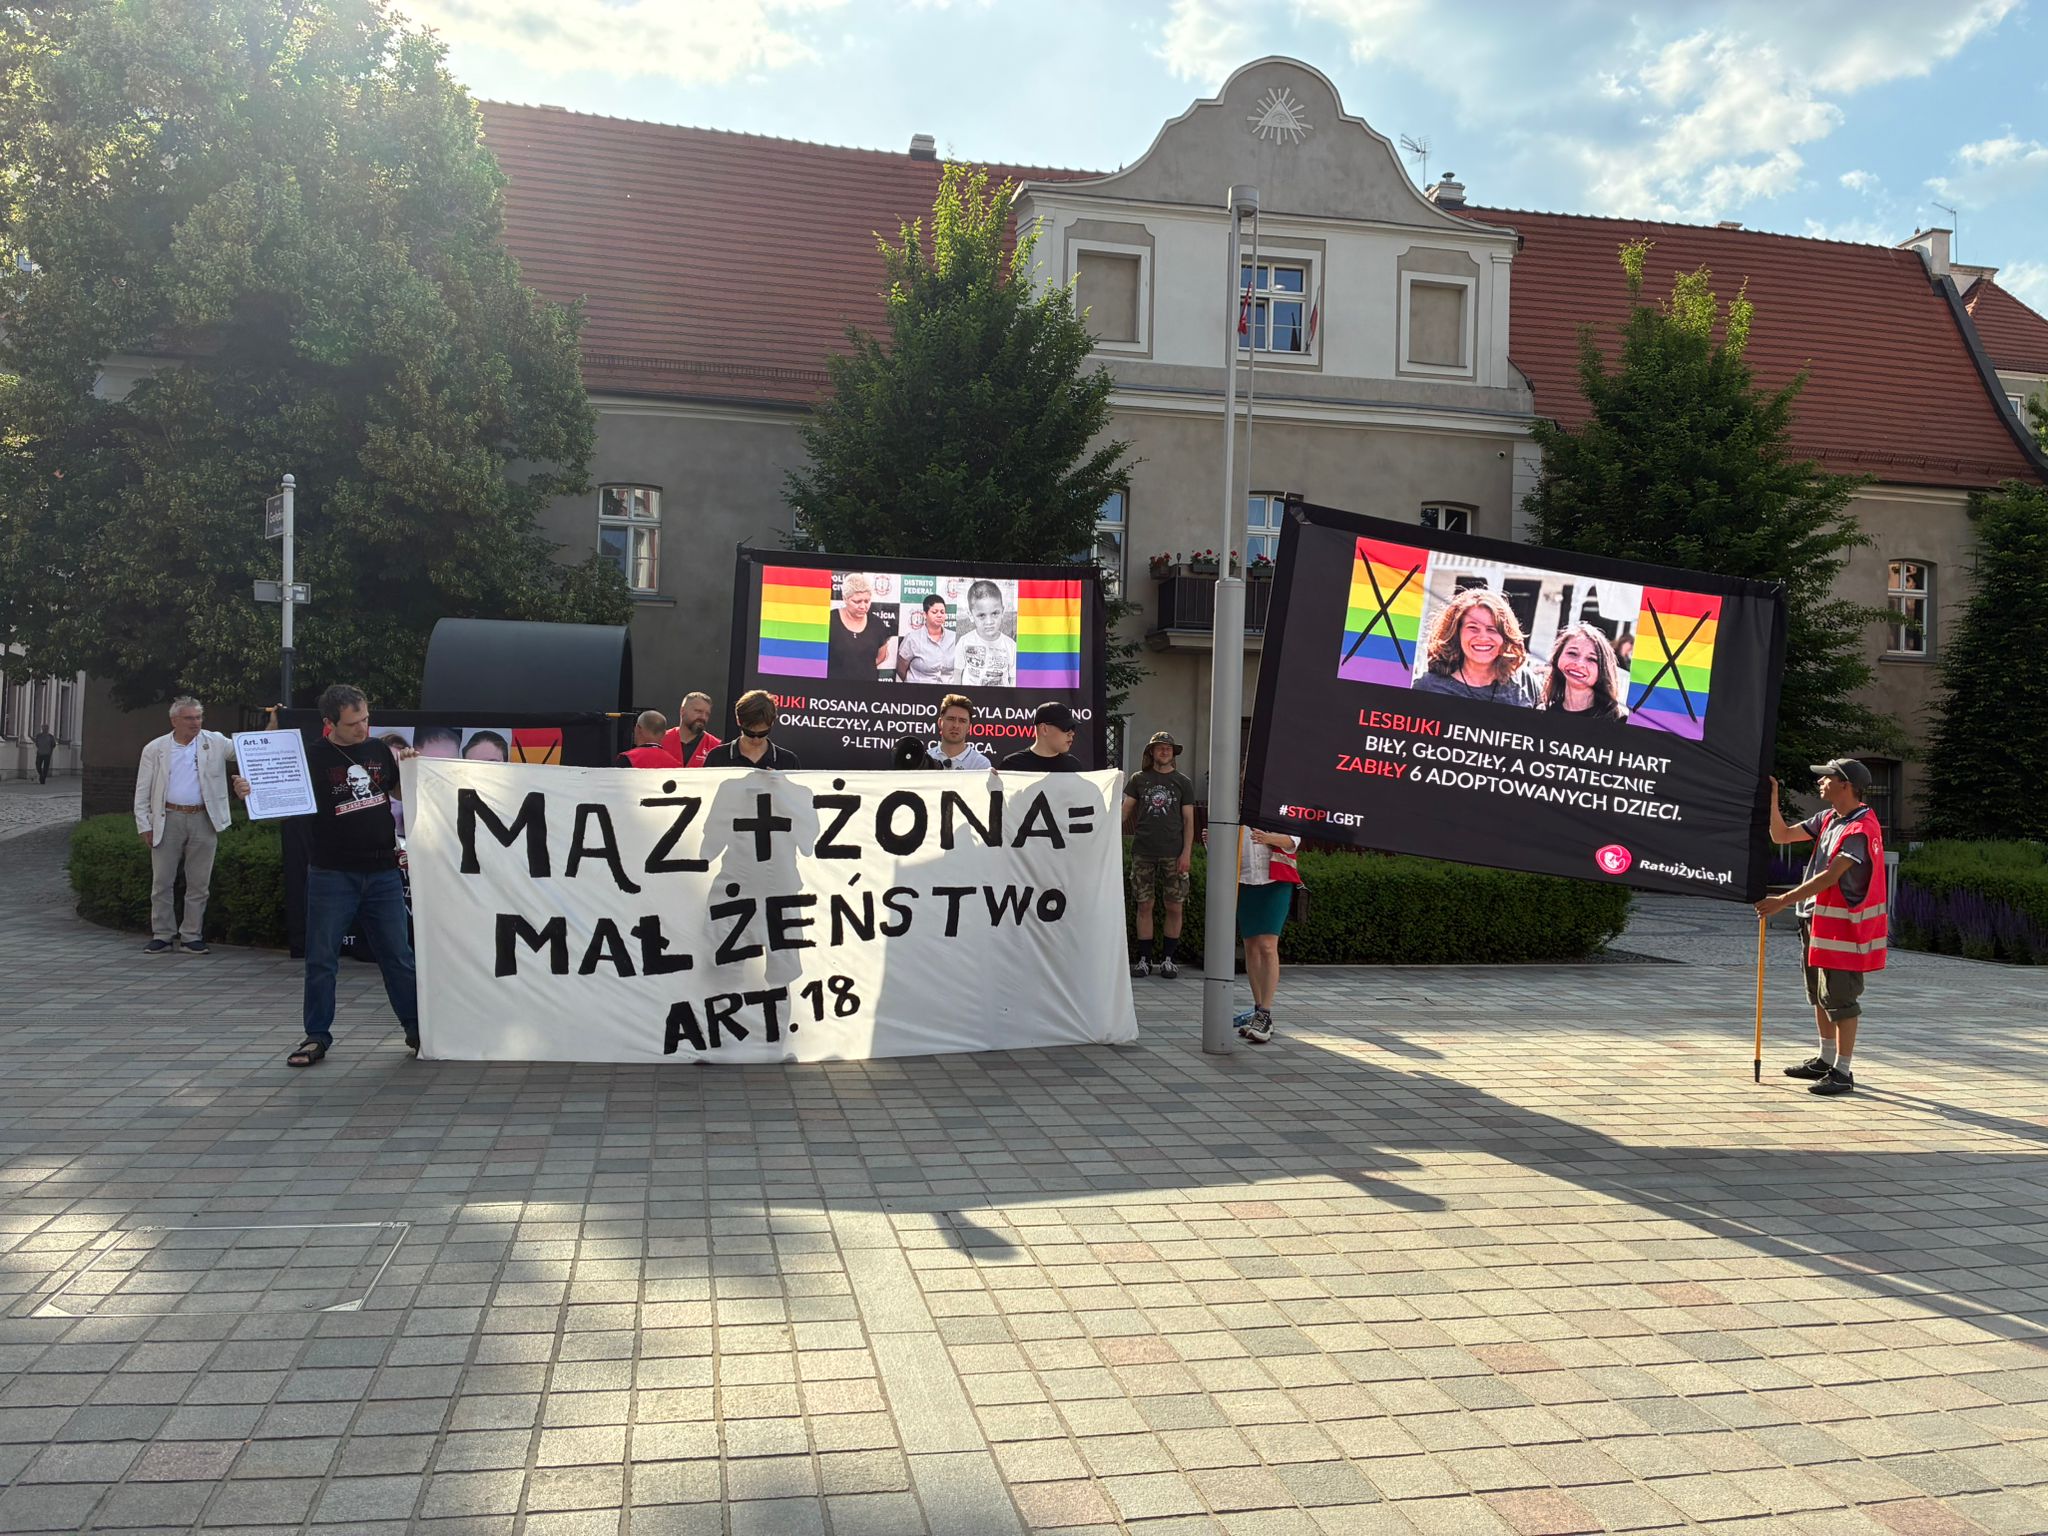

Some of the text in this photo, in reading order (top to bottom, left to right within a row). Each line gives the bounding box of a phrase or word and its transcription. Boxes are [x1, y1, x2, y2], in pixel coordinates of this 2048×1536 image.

[904, 579, 934, 587] DISTRITO
[904, 587, 934, 595] FEDERAL
[772, 694, 806, 709] BIJKI
[809, 698, 868, 713] ROSANA
[871, 702, 938, 717] CANDIDO
[779, 713, 872, 732] OKALECZYŁY,
[873, 720, 884, 732] A
[887, 720, 936, 734] POTEM
[1358, 709, 1671, 774] LESBIJKI JENNIFER I SARAH HART
[1365, 735, 1657, 795] BIŁY, GŁODZIŁY, A OSTATECZNIE
[1336, 754, 1683, 821] ZABIŁY 6 ADOPTOWANYCH DZIECI.
[1279, 804, 1364, 827] #STOPLGBT
[456, 779, 709, 894] MĄŻ
[1639, 859, 1733, 884] RatujŻycie.pl
